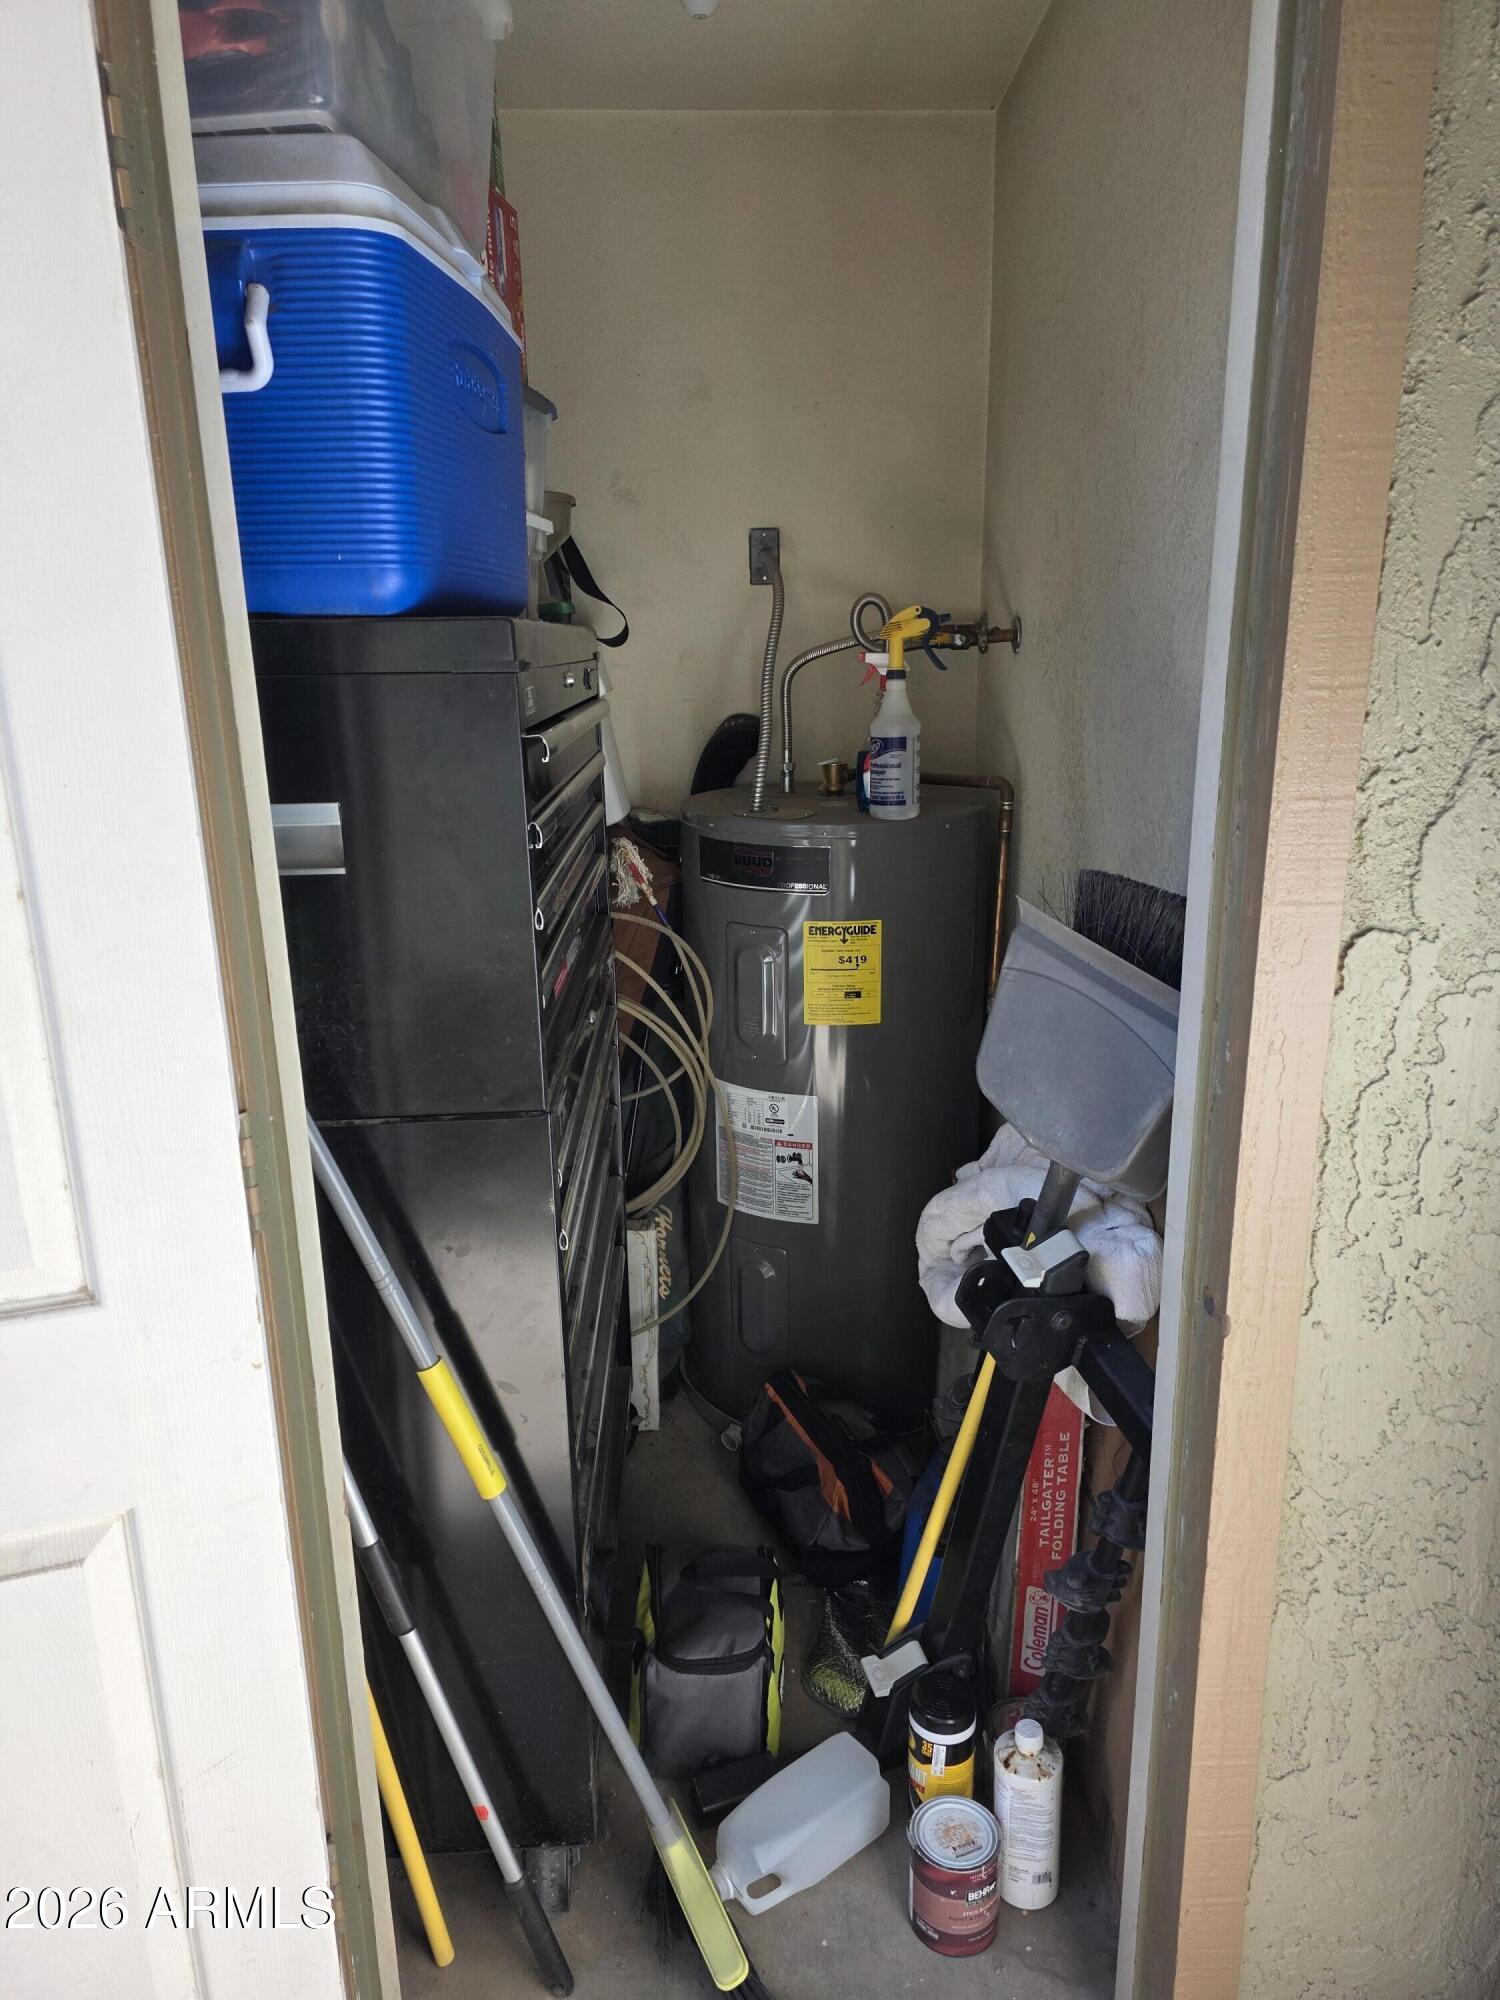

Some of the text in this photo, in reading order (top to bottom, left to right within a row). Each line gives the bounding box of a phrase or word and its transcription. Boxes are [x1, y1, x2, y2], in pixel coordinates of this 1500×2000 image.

[734, 854, 773, 869] RUUD
[808, 924, 877, 938] ENERGYGUIDE
[838, 954, 867, 965] $419
[783, 1141, 811, 1149] DANGER
[1051, 1431, 1071, 1561] FOLDING TABLE
[1023, 1606, 1049, 1671] Coleman
[922, 1740, 933, 1753] 35
[968, 1885, 989, 1902] BEHR
